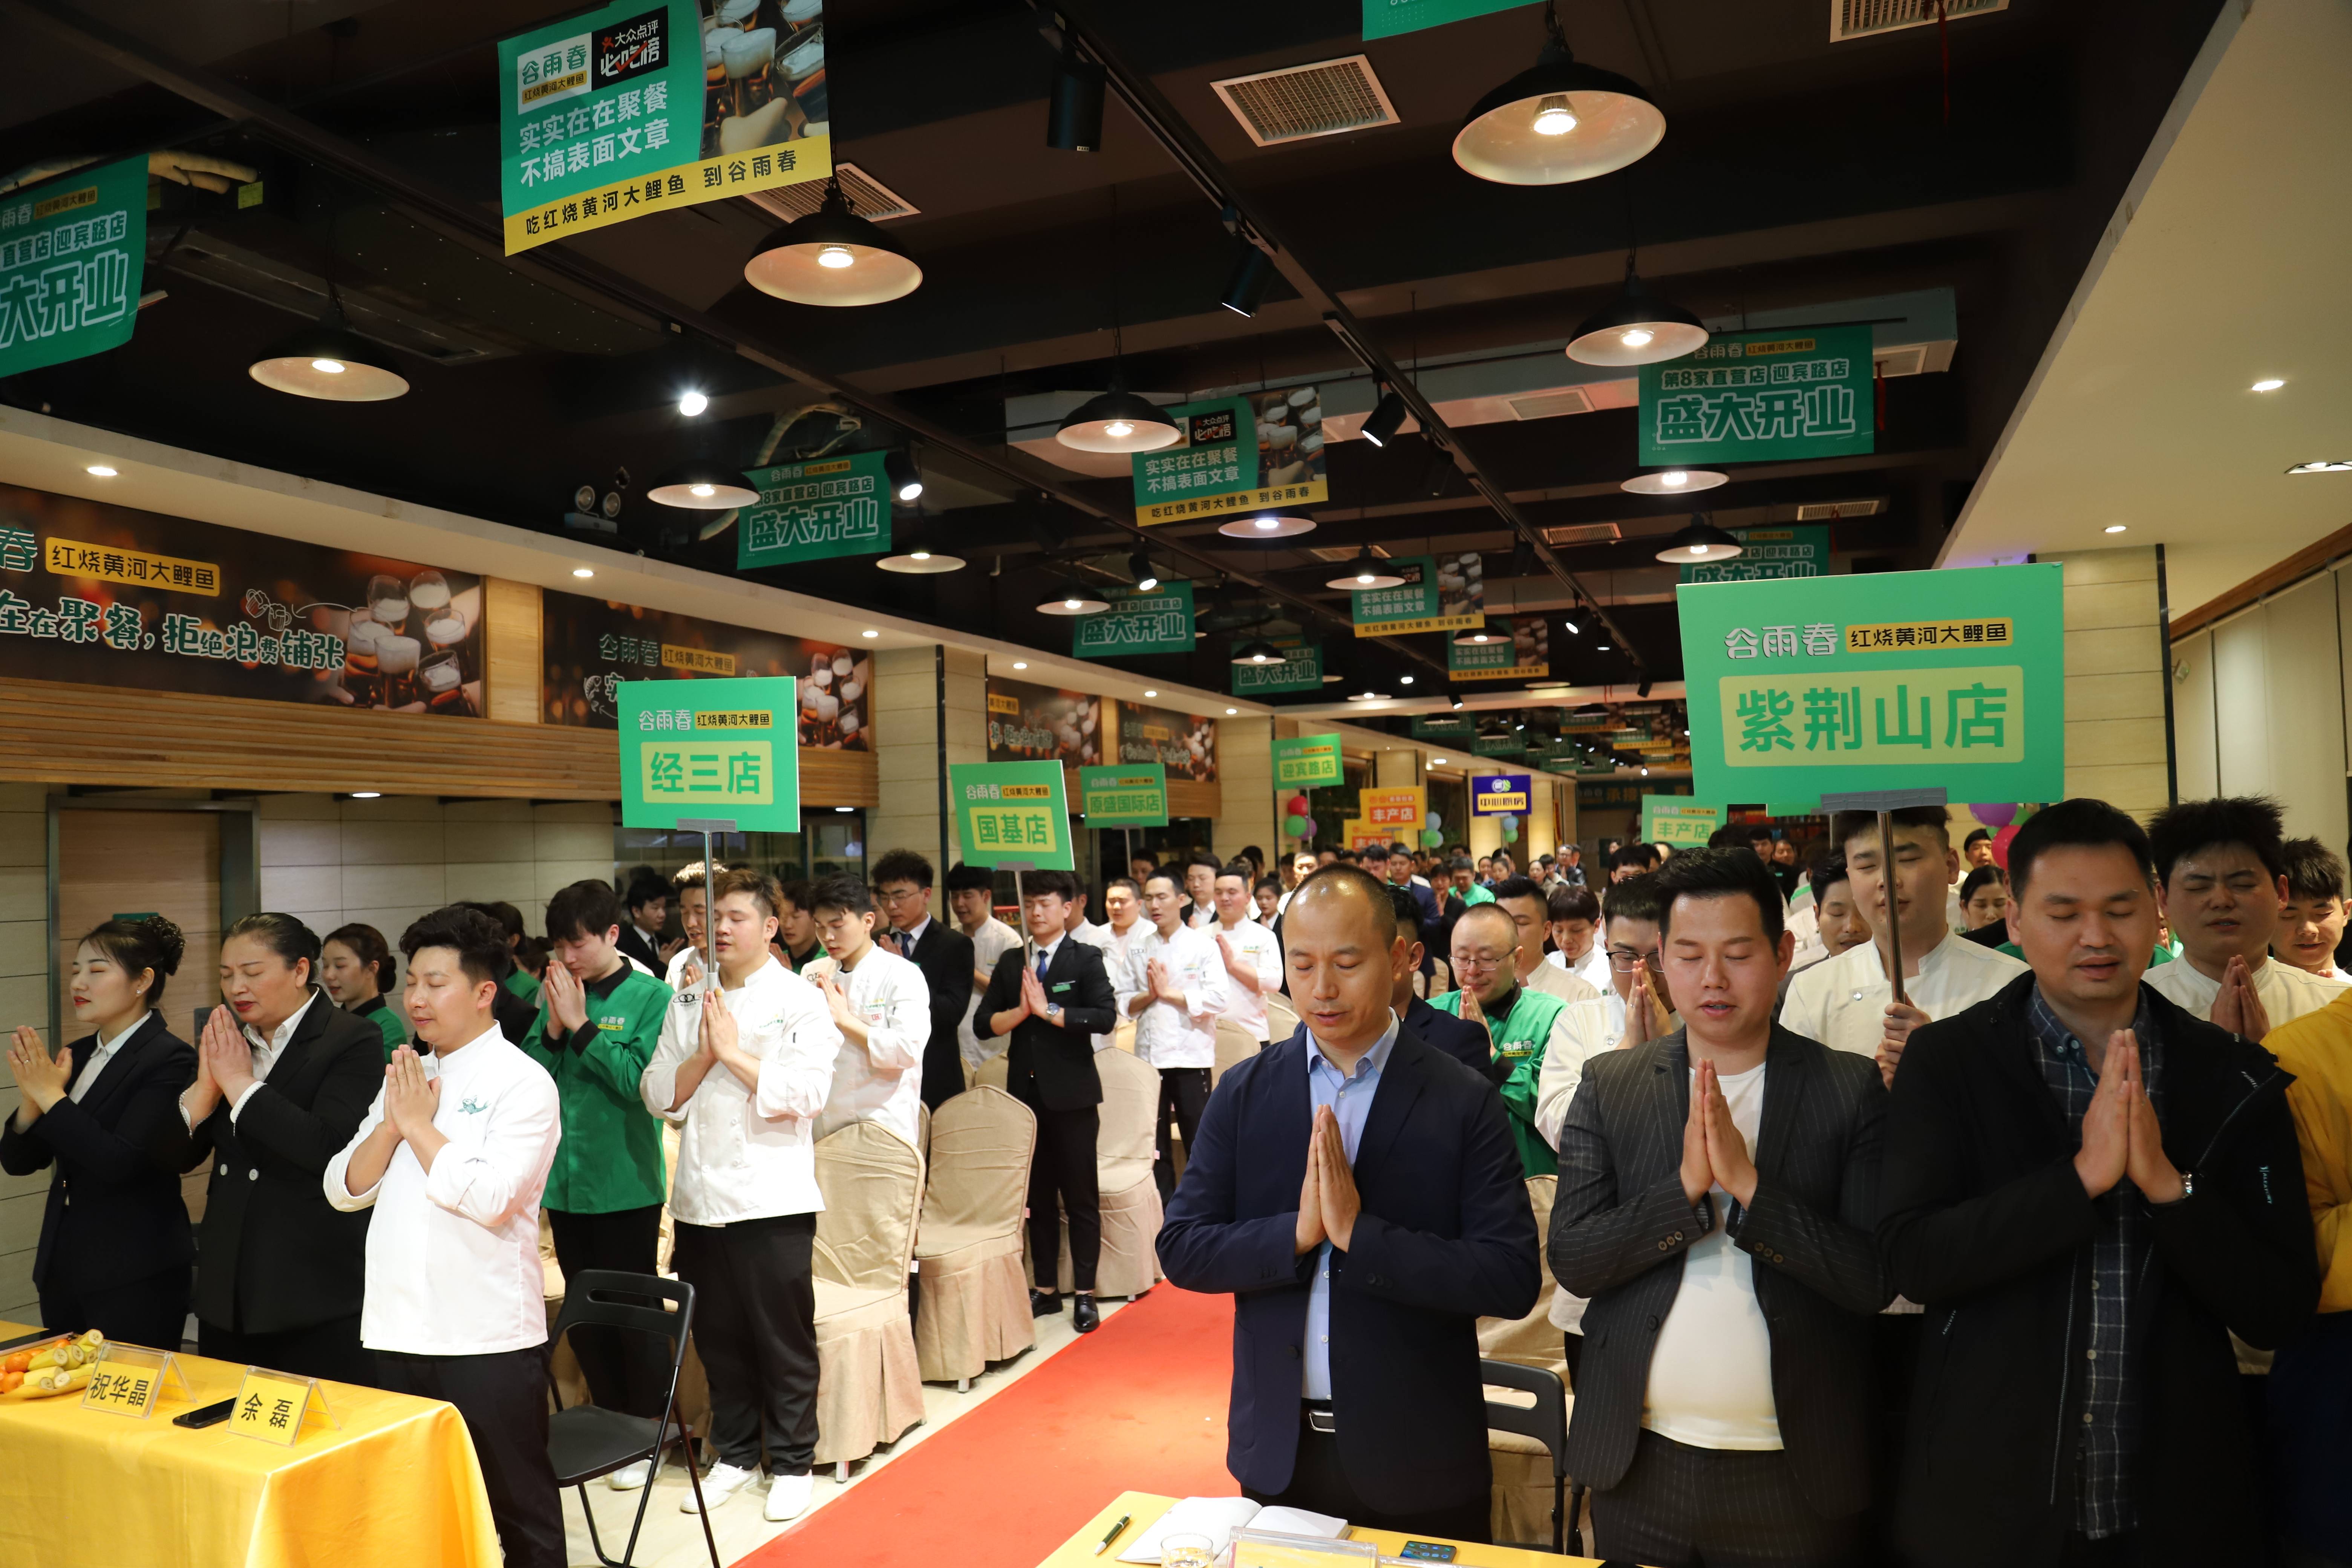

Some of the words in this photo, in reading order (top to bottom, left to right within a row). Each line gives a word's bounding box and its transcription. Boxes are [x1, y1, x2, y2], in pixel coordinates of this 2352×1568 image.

[614, 19, 659, 47] 大众点评
[522, 44, 587, 85] 谷雨春
[600, 38, 660, 77] 必吃榜
[524, 72, 585, 101] 红烧黄河大鲤鱼
[519, 80, 668, 154] 实实在在聚餐
[520, 118, 670, 188] 不搞表面文章
[526, 174, 686, 235] 吃红烧黄河大鲤鱼
[704, 149, 797, 188] 到谷雨春
[54, 210, 127, 256] 迎宾路店
[0, 249, 129, 349] 大开业
[1694, 343, 1743, 360] 谷雨春
[1747, 340, 1813, 354] 红烧黄河大鲤鱼
[1661, 365, 1767, 390] 第8家直营店
[1771, 358, 1849, 384] 迎宾路店
[1203, 415, 1230, 426] 大众点评
[1657, 384, 1855, 444] 盛大开业
[1194, 423, 1231, 441] 必吃榜
[771, 466, 802, 481] 谷雨春
[1145, 447, 1238, 476] 实实在在聚餐
[821, 476, 874, 498] 迎宾路店
[1147, 466, 1240, 493] 不搞表面文章
[1152, 495, 1250, 518] 吃红烧黄河大鲤鱼
[1259, 486, 1309, 502] 到谷雨春
[749, 497, 879, 551] 盛大开业
[52, 545, 214, 590] 红烧黄河大鲤鱼
[1361, 588, 1424, 604] 实实在在聚餐
[1362, 601, 1425, 616] 不搞表面文章
[1082, 612, 1186, 645] 盛大开业
[1724, 622, 1838, 658] 谷雨春
[1851, 622, 2007, 647] 红烧黄河大鲤鱼
[599, 634, 659, 667] 谷雨春
[665, 649, 733, 672] 红烧黄河大鲤鱼
[1239, 659, 1317, 686] 盛大开业
[638, 709, 692, 731] 谷雨春
[697, 712, 770, 726] 红烧黄河大鲤鱼
[1736, 683, 2007, 752] 紫荆山店
[650, 752, 761, 794] 经三店
[966, 784, 1000, 799] 谷雨春
[977, 814, 1047, 844] 国基店
[1373, 807, 1413, 822] 丰产店
[1657, 822, 1711, 839] 丰产店
[90, 1373, 149, 1408] 祝华晶
[241, 1392, 293, 1429] 余磊
